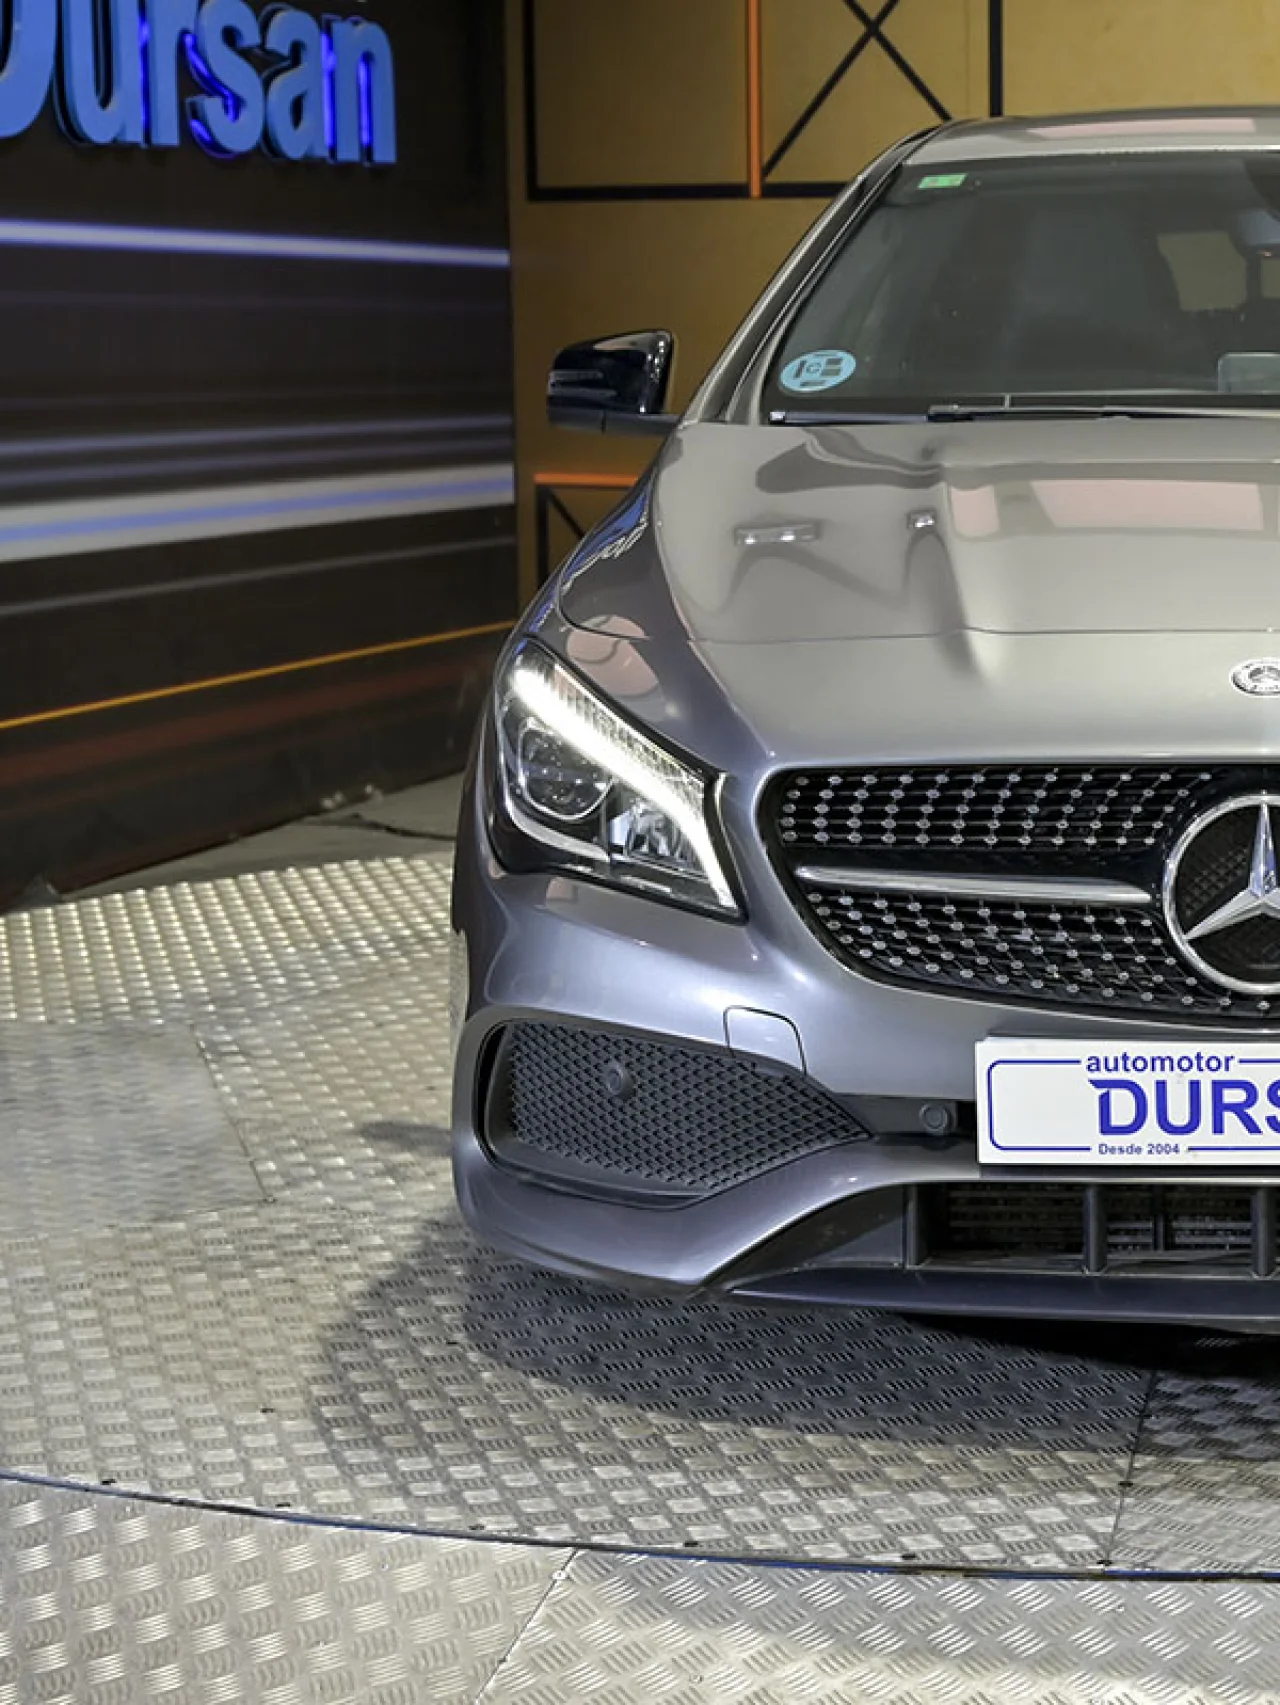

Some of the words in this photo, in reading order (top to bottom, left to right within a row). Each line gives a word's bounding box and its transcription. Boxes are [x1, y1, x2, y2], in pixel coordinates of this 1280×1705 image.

[1086, 1051, 1235, 1074] automotor
[1098, 1143, 1143, 1155] Desde
[1147, 1143, 1181, 1155] 2004
